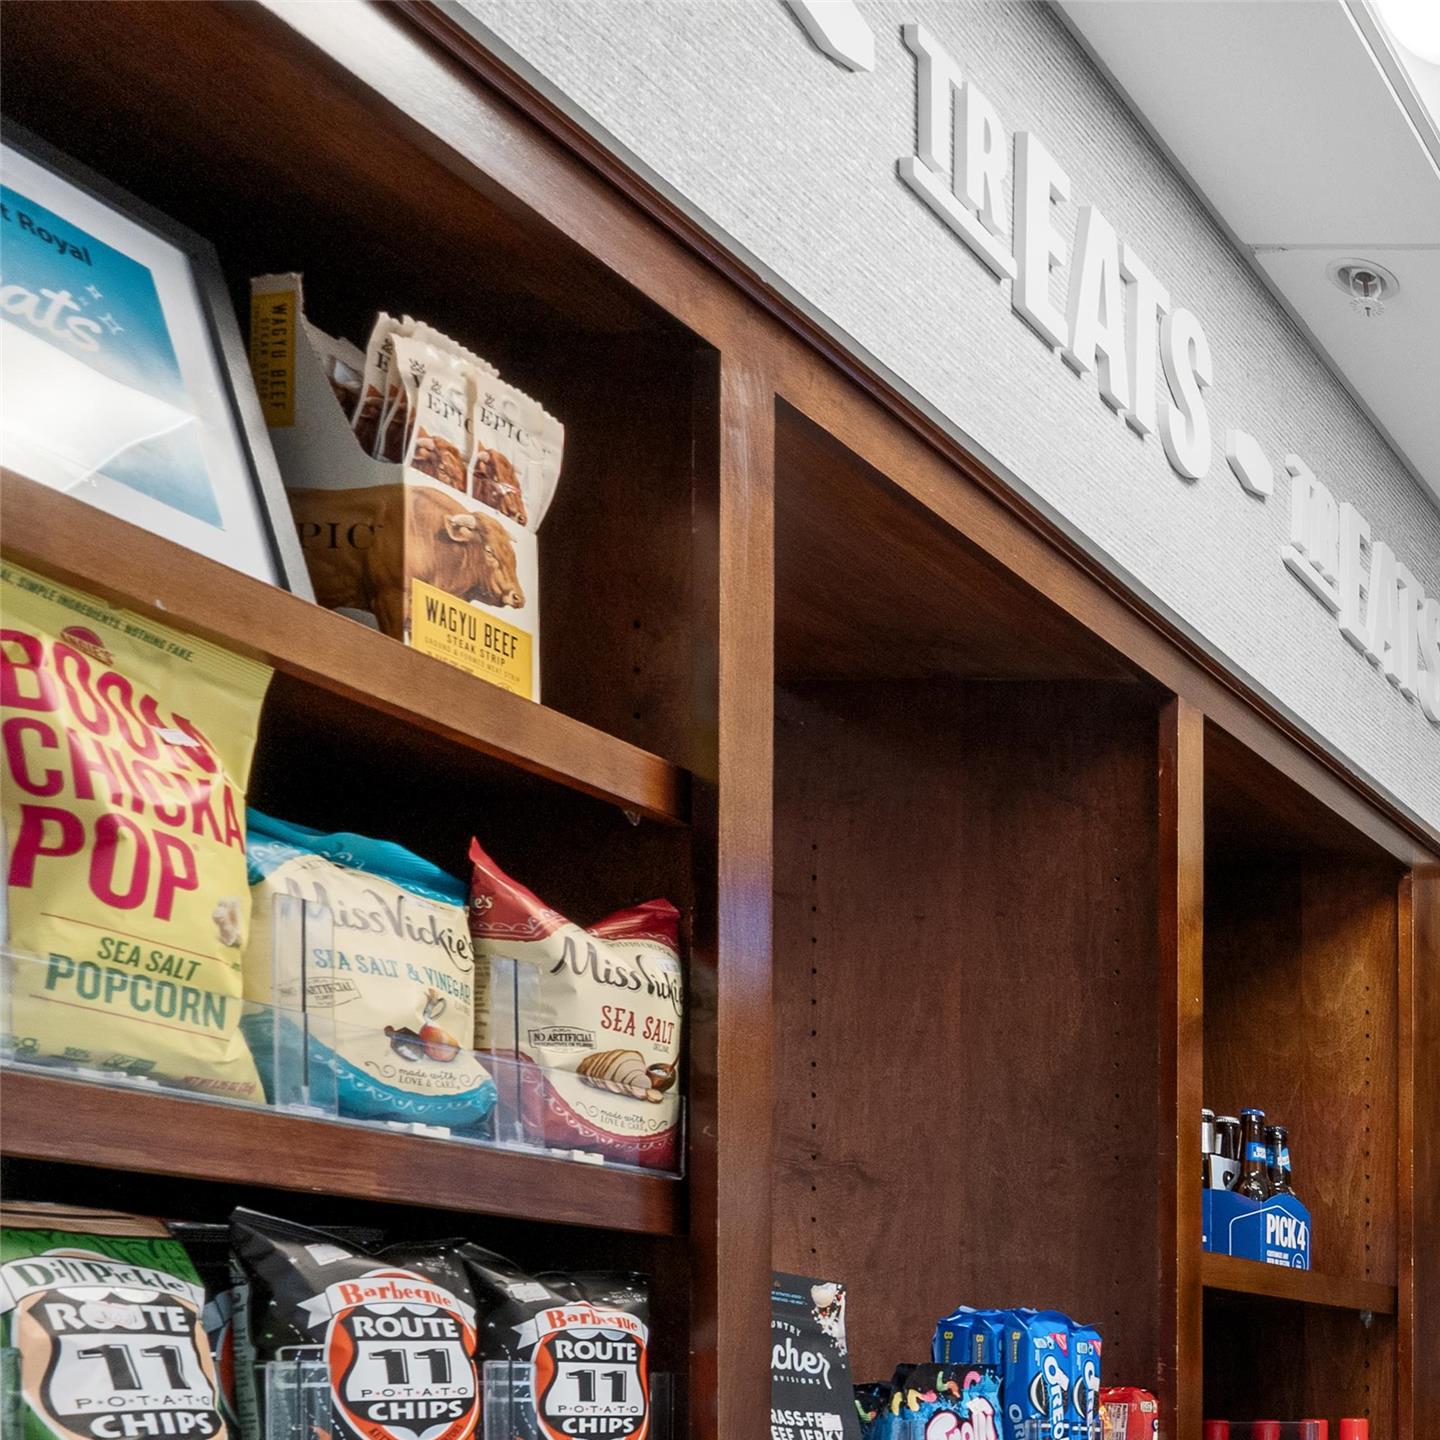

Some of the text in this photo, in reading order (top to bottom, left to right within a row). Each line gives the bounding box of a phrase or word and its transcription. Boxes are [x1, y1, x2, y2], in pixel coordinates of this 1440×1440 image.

[17, 211, 93, 267] Royal
[270, 302, 289, 411] WAGYU BEEF
[479, 407, 530, 448] EPIC
[124, 620, 168, 652] NOTHING
[425, 596, 518, 659] WAGYU BEEF
[446, 634, 506, 667] STEAK STRIP
[8, 804, 199, 922] POP
[97, 936, 202, 982] SEA SALT
[313, 948, 424, 985] SEA SALT &
[550, 935, 643, 991] Miss
[45, 952, 228, 1031] POPCORN
[547, 1032, 593, 1042] ARTIFICIAL
[600, 1005, 675, 1045] SEA SALT
[398, 1067, 457, 1081] made with
[398, 1075, 423, 1088] LOVE
[626, 1112, 645, 1123] with
[1266, 1212, 1307, 1251] PICK 4
[12, 1261, 185, 1293] Dill Pickle
[338, 1281, 453, 1308] Barbeque
[45, 1303, 190, 1333] ROUTE
[351, 1316, 460, 1338] ROUTE
[546, 1309, 639, 1331] Barbeque
[369, 1348, 452, 1385] 11
[555, 1340, 638, 1361] ROUTE
[77, 1344, 192, 1391] 11
[565, 1369, 627, 1403] 11
[1043, 1355, 1070, 1440] OREO
[90, 1411, 215, 1438] CHIPS
[367, 1400, 464, 1421] CHIPS
[561, 1417, 634, 1434] CHIPS
